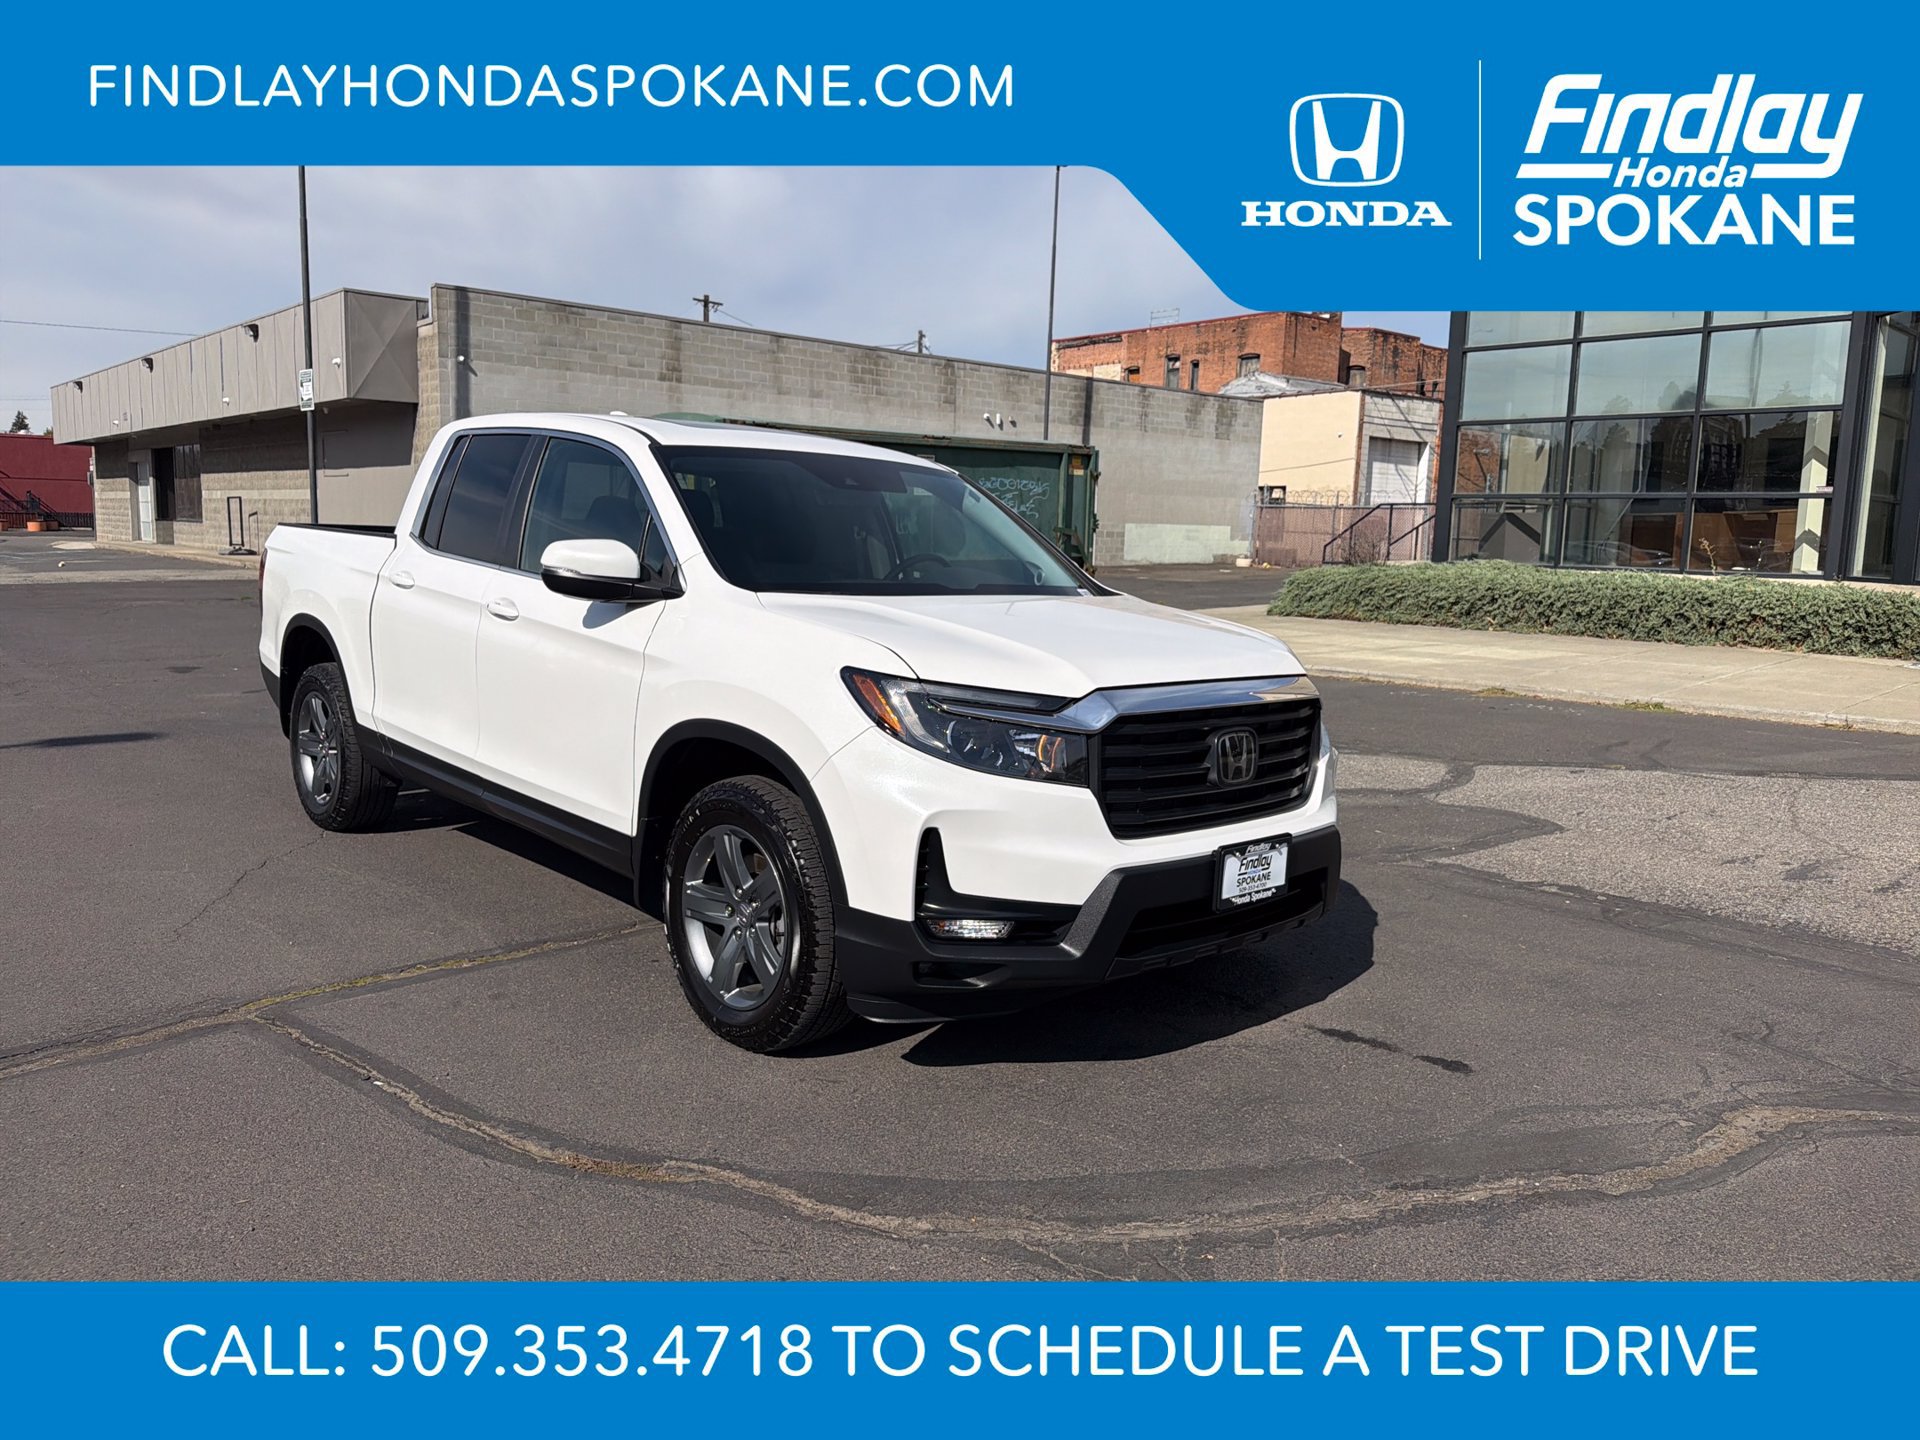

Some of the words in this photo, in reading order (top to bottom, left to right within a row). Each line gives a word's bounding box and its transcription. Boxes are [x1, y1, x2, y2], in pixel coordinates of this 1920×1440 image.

[1239, 854, 1272, 872] Findlay
[1236, 871, 1271, 887] SPOKANE
[1251, 890, 1272, 902] Spokane
